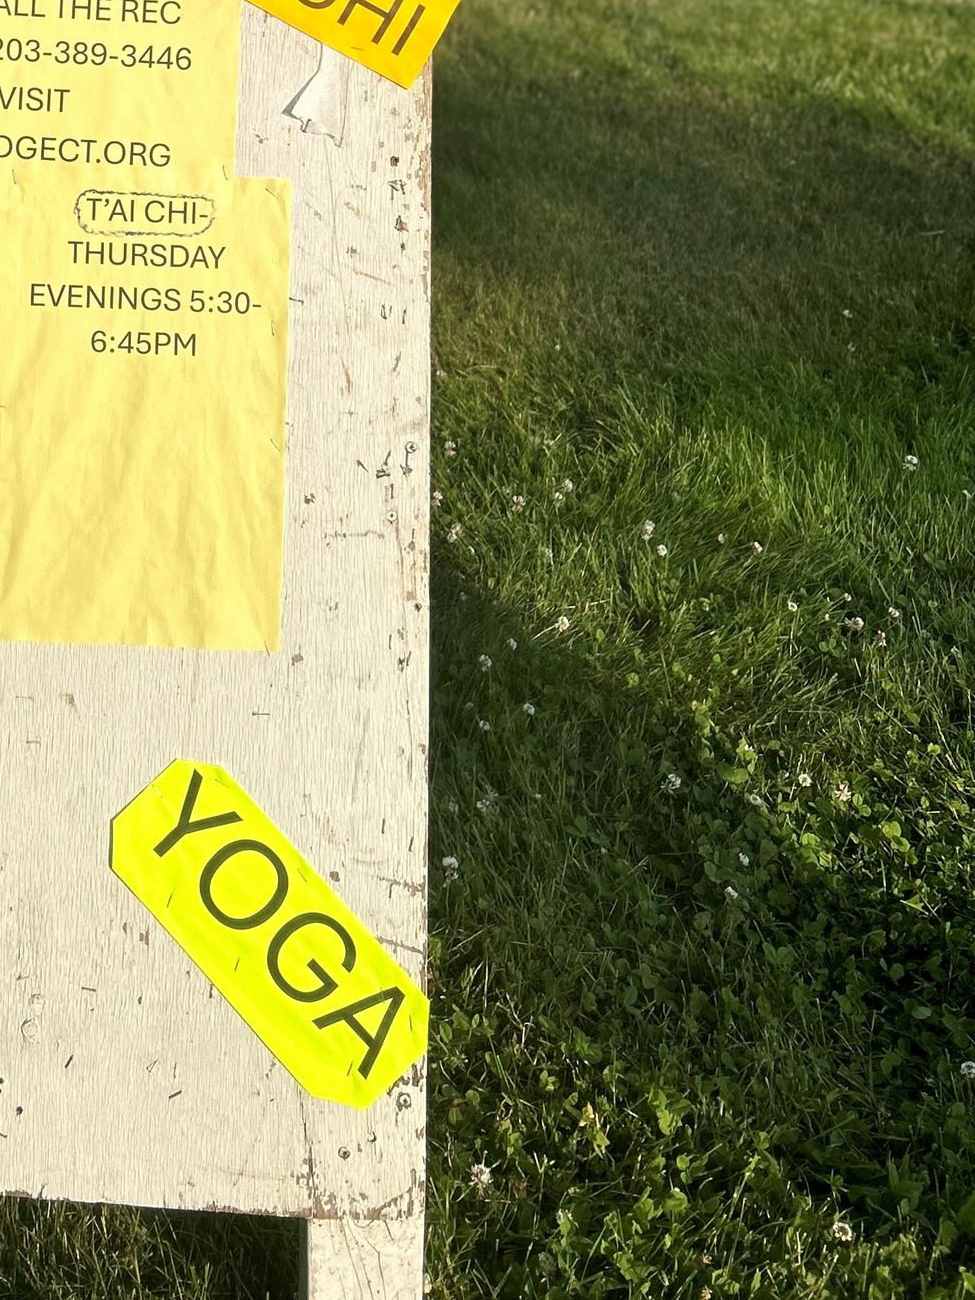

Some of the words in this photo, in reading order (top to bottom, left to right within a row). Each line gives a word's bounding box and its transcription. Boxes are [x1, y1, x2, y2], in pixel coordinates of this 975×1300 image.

[85, 197, 136, 223] T'AI
[144, 200, 209, 225] CHI-
[67, 240, 226, 270] THURSDAY
[29, 283, 182, 312] EVENINGS
[189, 290, 262, 315] 5:30-
[90, 330, 198, 357] 6:45PM
[152, 767, 407, 1081] YOGA
